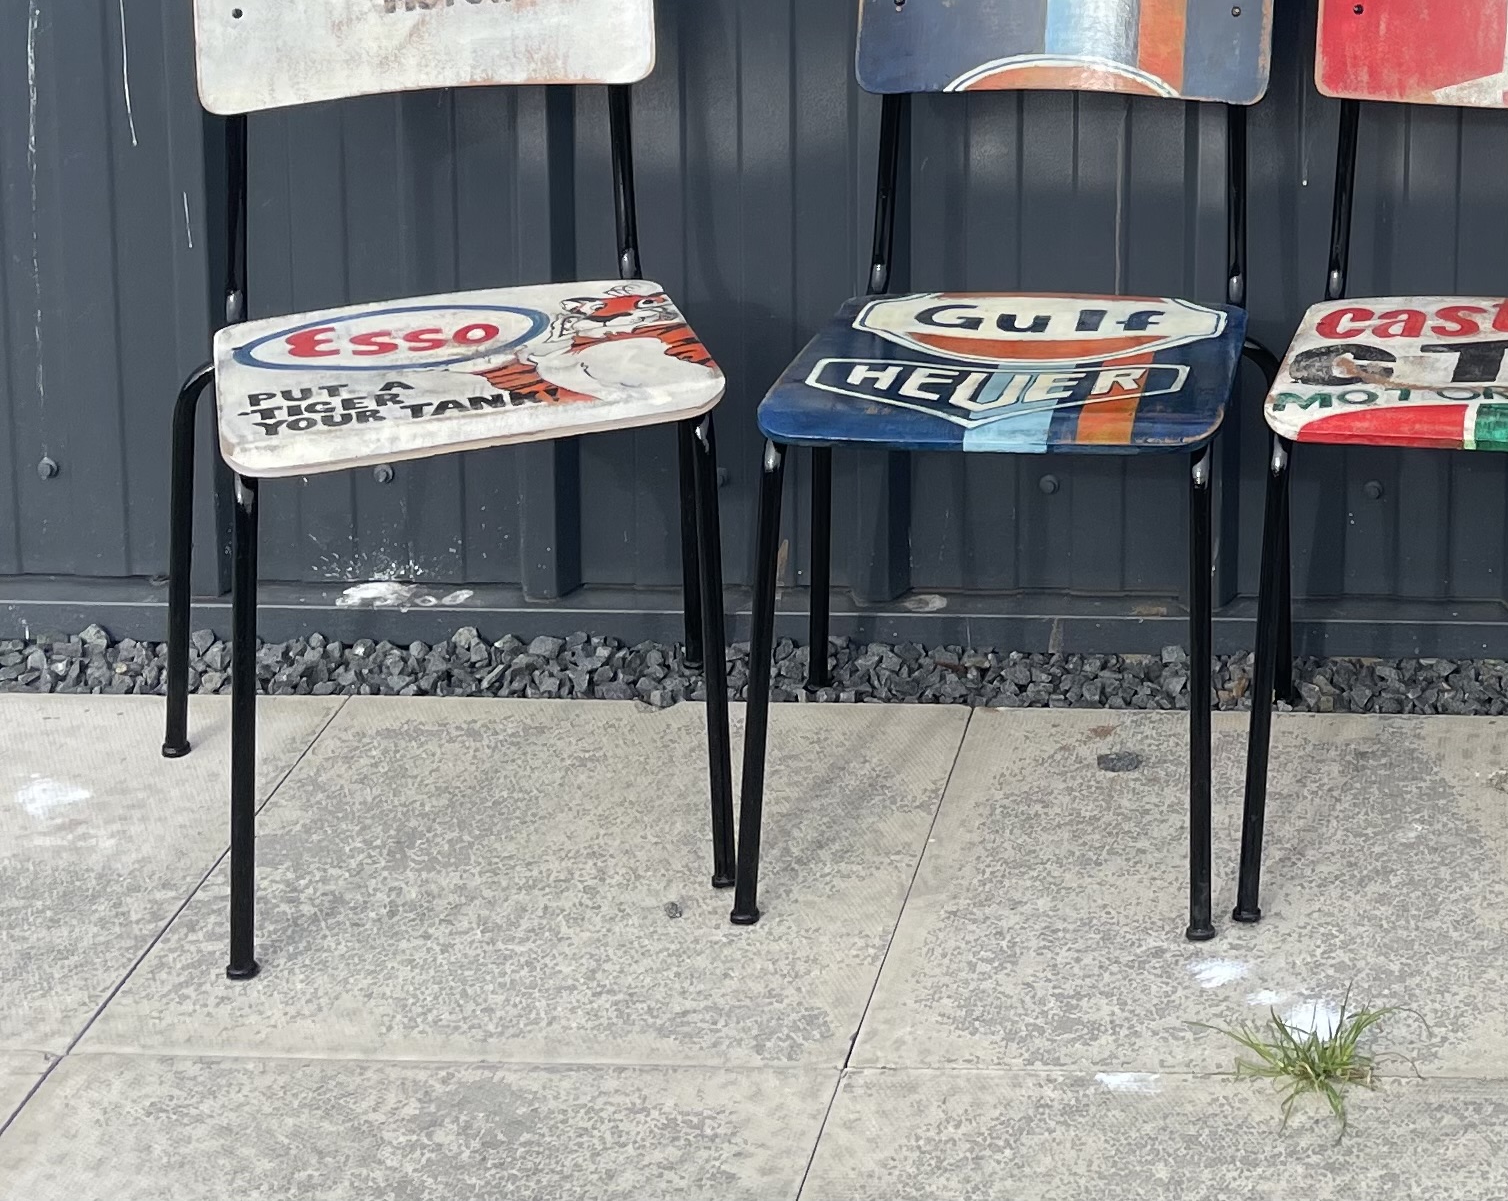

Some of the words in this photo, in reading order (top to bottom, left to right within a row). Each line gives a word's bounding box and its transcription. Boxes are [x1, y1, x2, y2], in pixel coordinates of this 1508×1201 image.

[247, 383, 349, 408] PUT
[378, 381, 415, 392] A
[846, 364, 1150, 412] HEUER
[252, 408, 387, 436] YOUR
